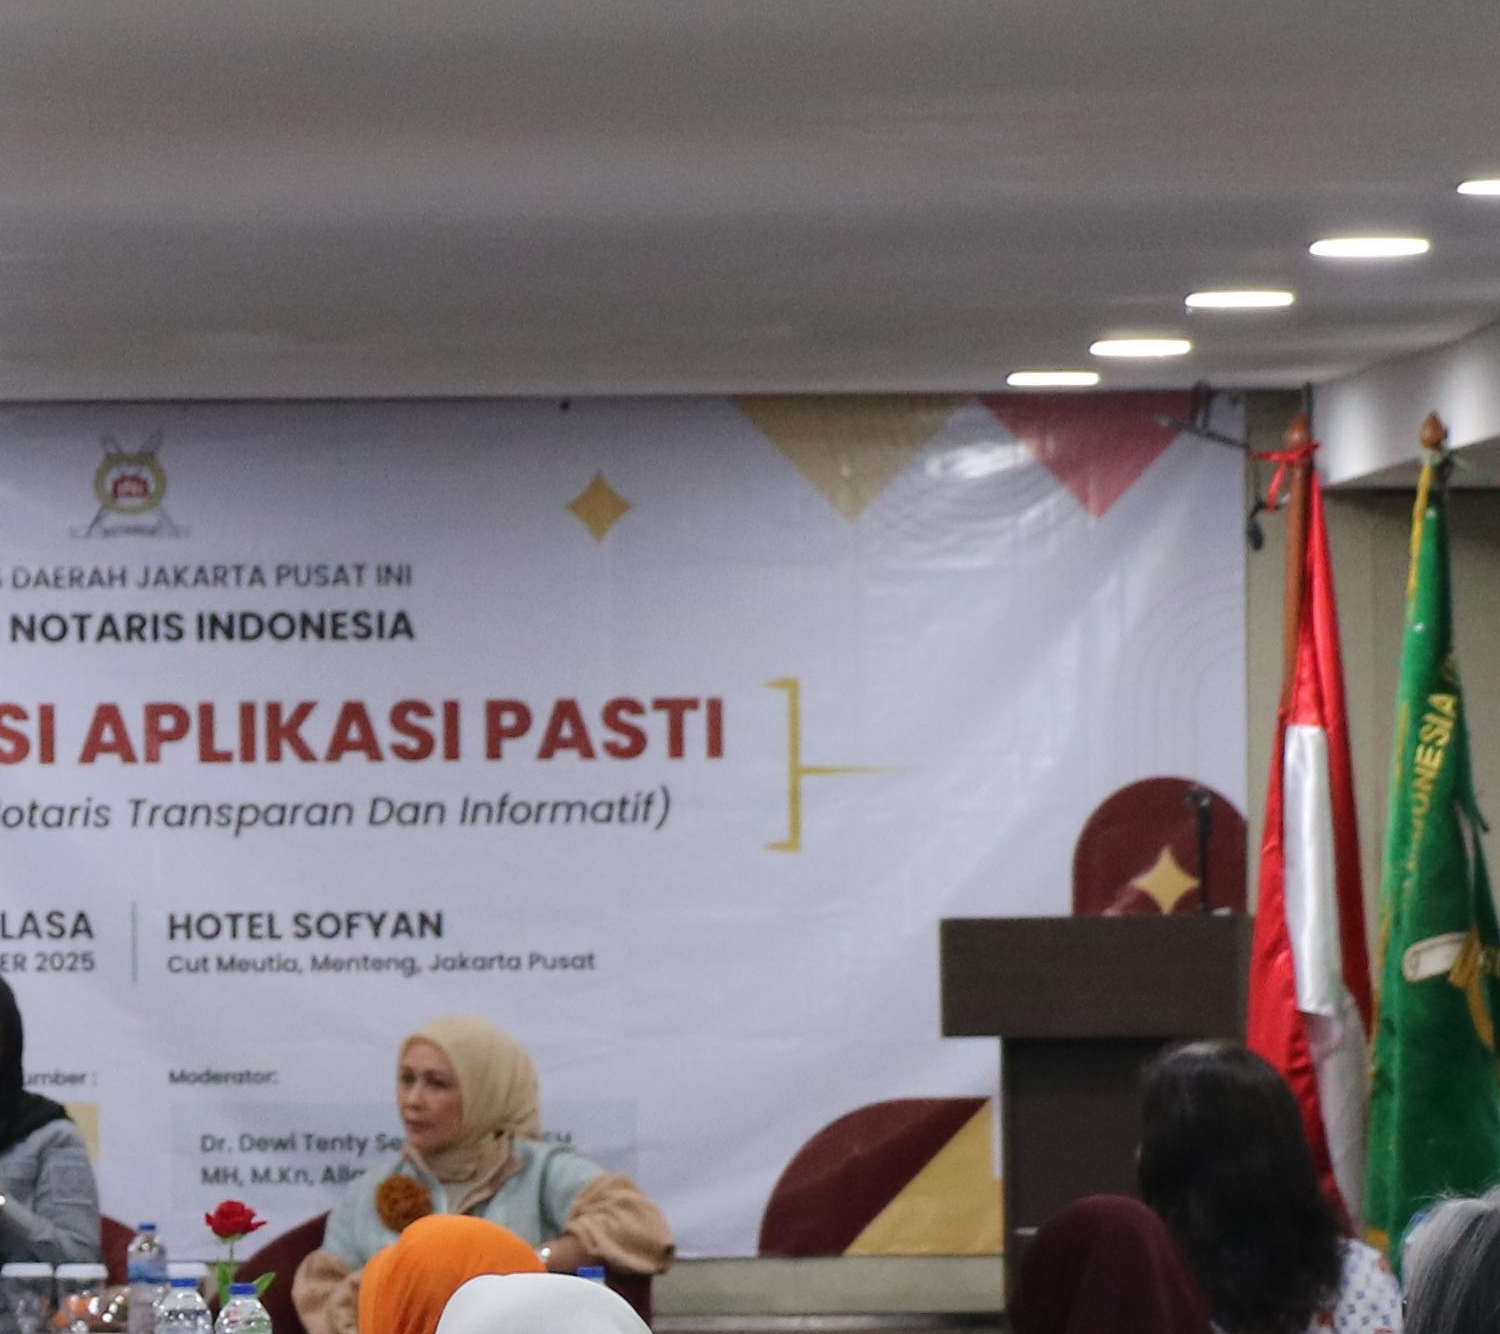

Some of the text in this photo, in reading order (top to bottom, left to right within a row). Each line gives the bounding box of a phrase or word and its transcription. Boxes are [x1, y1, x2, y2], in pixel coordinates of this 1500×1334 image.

[12, 565, 128, 591] DAERAH
[136, 563, 266, 589] JAKARTA
[274, 562, 369, 588] PUSAT
[376, 562, 412, 587] INI
[10, 611, 184, 642] NOTARIS
[197, 610, 415, 640] INDONESIA
[79, 698, 461, 765] APLIKASI
[485, 696, 725, 760] PASTI
[128, 797, 353, 837] Transparan
[369, 797, 447, 827] Dan
[459, 786, 673, 831] Informatif)
[168, 910, 444, 940] HOTEL SOFYAN
[35, 952, 95, 972] 2025
[167, 952, 595, 978] Cut Meutia, Menteng, Jakarta Pusat
[169, 1069, 279, 1085] Moderator:
[201, 1134, 233, 1153] Dr.
[240, 1133, 295, 1153] Dewi
[304, 1133, 367, 1158] Tenty
